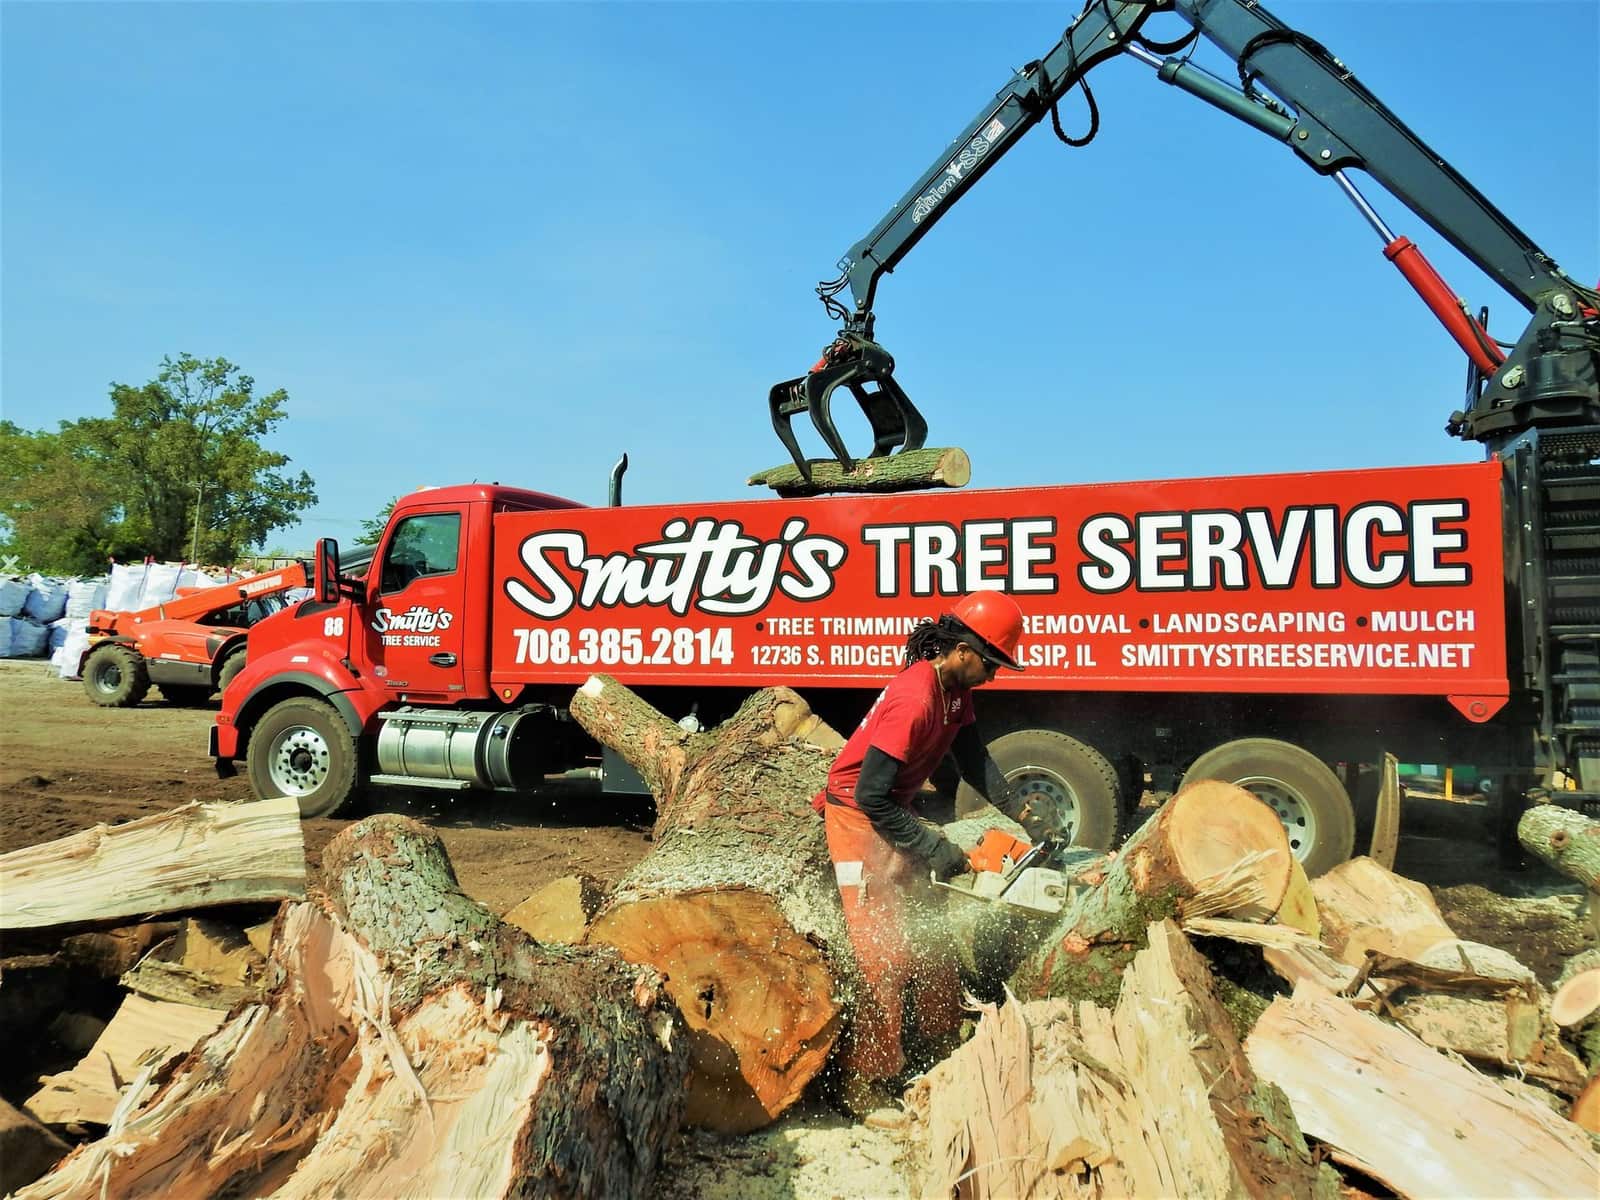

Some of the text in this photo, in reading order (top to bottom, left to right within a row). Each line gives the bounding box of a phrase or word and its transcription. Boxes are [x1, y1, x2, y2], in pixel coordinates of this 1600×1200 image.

[505, 498, 1472, 619] Smitty's TREE SERVICE
[371, 606, 453, 633] Smitty's
[766, 617, 815, 636] TREE
[1153, 611, 1346, 634] LANDSCAPING
[1371, 609, 1475, 632] MULCH
[381, 635, 441, 647] TREE SERVICE
[513, 627, 735, 666] 708.385.2814
[751, 645, 802, 666] 12736
[806, 645, 827, 666] S.
[1017, 644, 1070, 669] LSIP,
[1076, 644, 1097, 667] IL
[1121, 642, 1475, 669] SMITTYSTREESERVICE.NET
